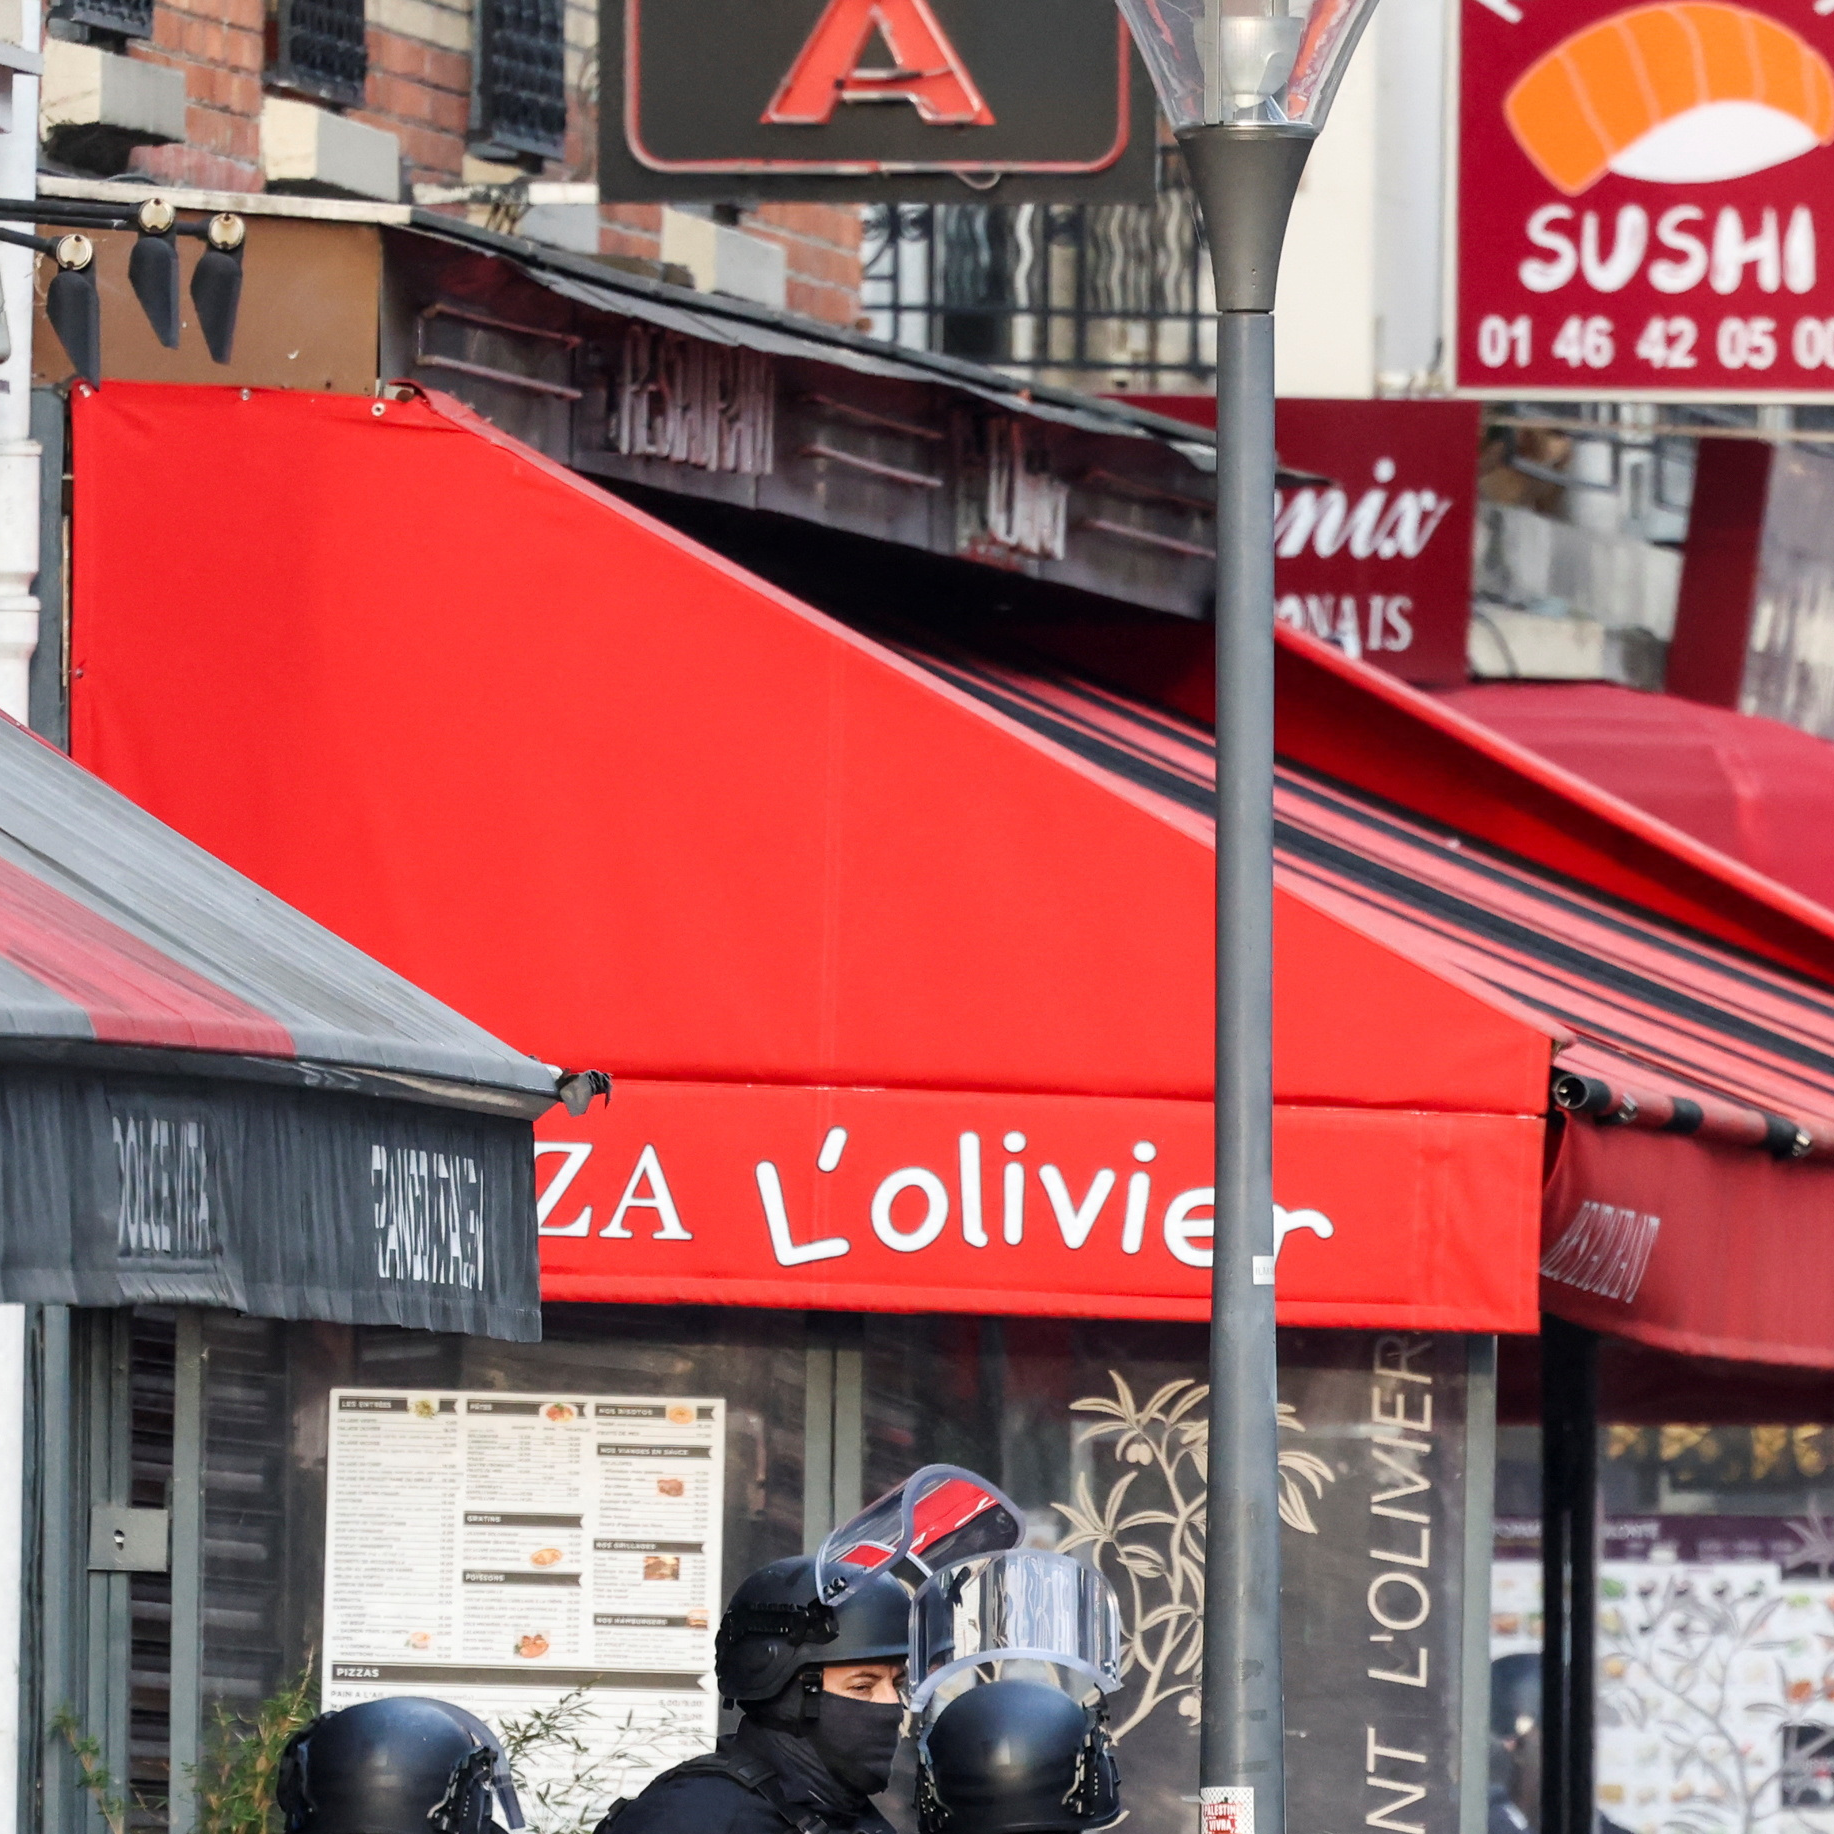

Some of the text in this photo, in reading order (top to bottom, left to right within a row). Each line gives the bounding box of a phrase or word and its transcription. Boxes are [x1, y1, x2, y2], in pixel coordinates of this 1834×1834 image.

[1519, 203, 1817, 294] SUSHI
[1478, 315, 1531, 369] 01
[1552, 316, 1614, 369] 46
[1635, 316, 1698, 370] 42
[1717, 317, 1778, 370] 05
[1275, 457, 1455, 560] nix
[754, 1125, 1334, 1269] L'olivier
[1367, 1334, 1434, 1690] L'OLIVIER
[336, 1667, 380, 1678] PIZZAS
